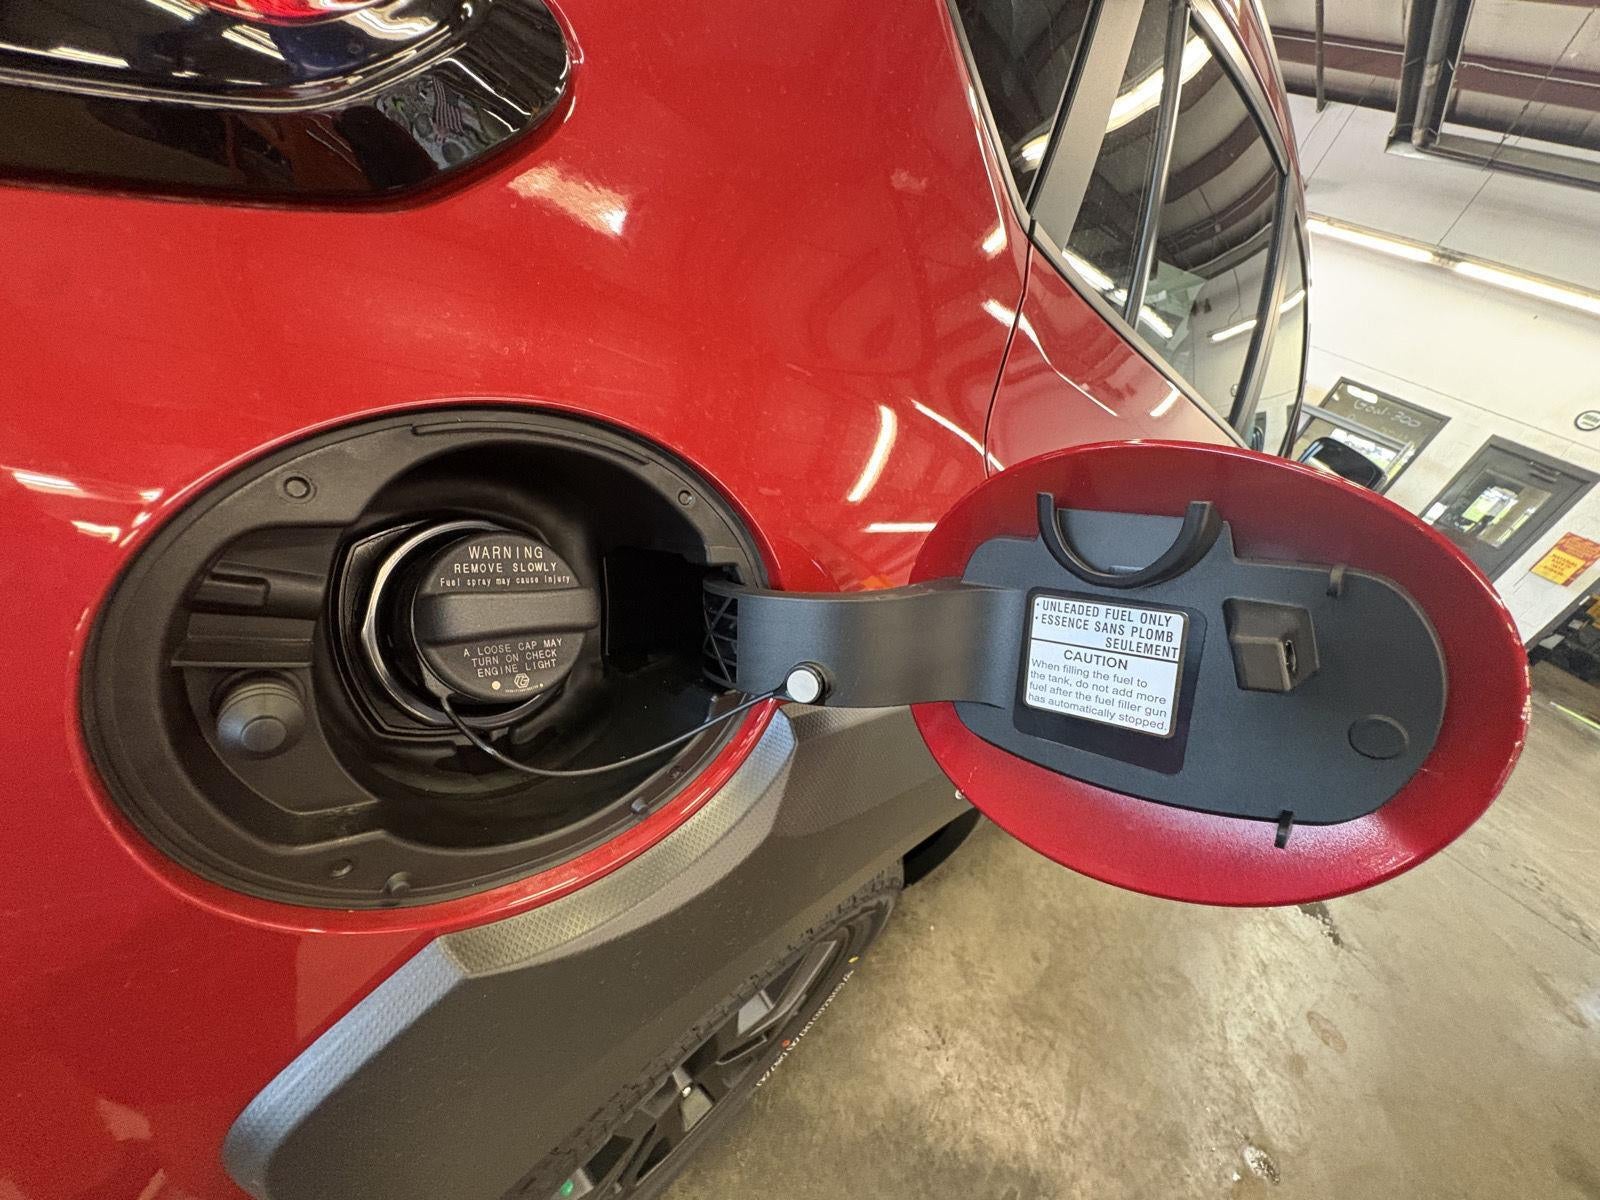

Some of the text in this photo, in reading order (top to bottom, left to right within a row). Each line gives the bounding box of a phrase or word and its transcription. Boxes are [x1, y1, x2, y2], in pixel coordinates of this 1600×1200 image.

[468, 546, 543, 559] WARNING
[454, 562, 557, 574] REMOVE SLOWLY
[440, 577, 461, 587] Fuel
[467, 578, 491, 587] spray
[495, 577, 511, 586] may
[516, 576, 539, 584] cause
[1042, 600, 1172, 628] UNLEADED FUEL ONLY
[1041, 614, 1174, 643] ESSENCE SANS PLOMB
[463, 638, 562, 657] A LOOSE CAP MAY
[471, 649, 557, 668] TURN ON CHECK
[1105, 637, 1178, 659] SEULEMENT
[477, 659, 557, 678] ENGINE LIGHT
[1063, 649, 1128, 671] CAUTION
[1031, 658, 1148, 689] When filling the fuel to
[1030, 669, 1167, 705] the tank, do not add more
[1029, 681, 1167, 718] fuel after the fuel filler gun
[1028, 692, 1168, 731] has automatically stopped.
